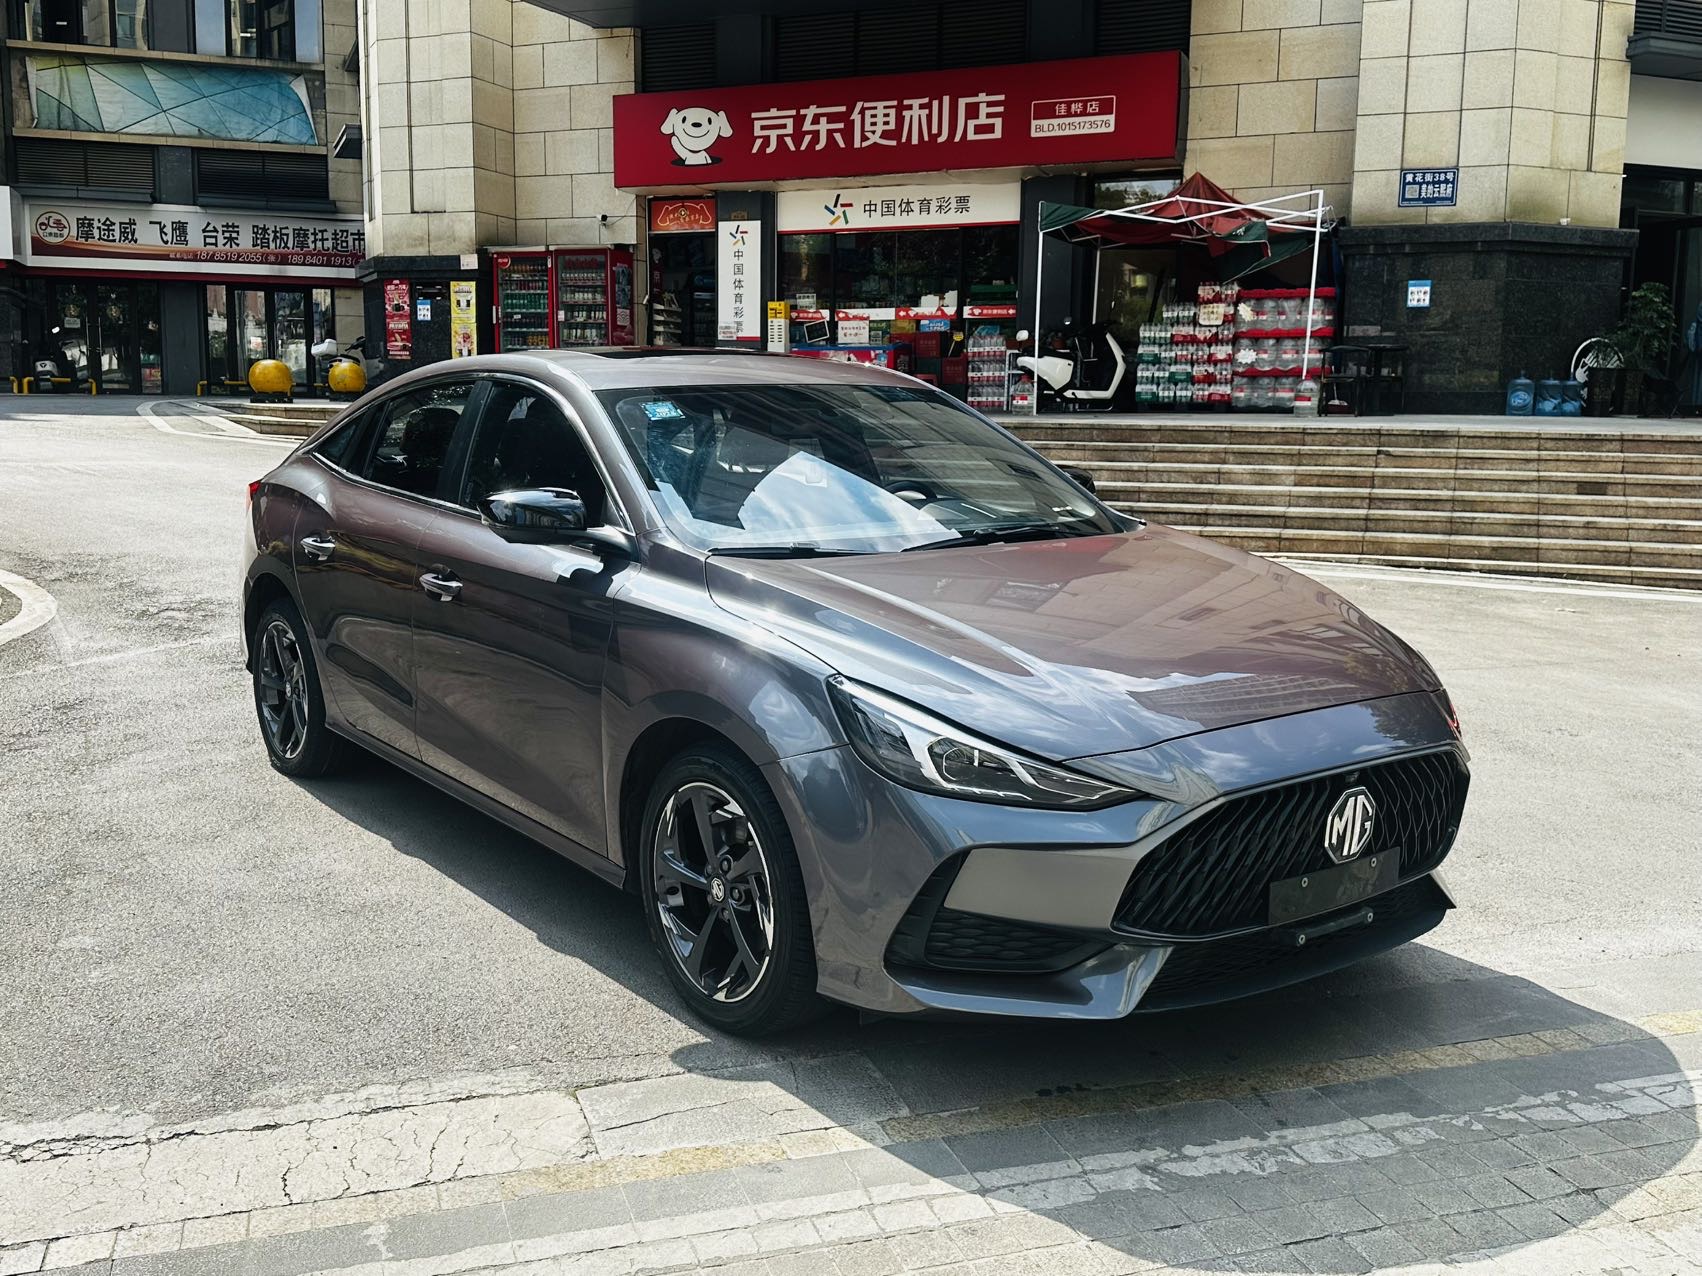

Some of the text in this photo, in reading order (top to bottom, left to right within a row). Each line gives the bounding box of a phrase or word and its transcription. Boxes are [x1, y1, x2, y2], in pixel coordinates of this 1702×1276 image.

[1055, 102, 1100, 116] 佳桦店
[751, 93, 1006, 154] 京东便利店
[1035, 119, 1111, 134] BLD.1015173576
[1405, 172, 1454, 183] 黄花街38号
[863, 195, 971, 218] 中国体育彩票
[75, 215, 365, 255] 摩途威 飞鹰 台荣 踏板摩托超市
[196, 250, 212, 260] 187
[214, 251, 237, 261] 8519
[287, 254, 303, 264] 189
[305, 255, 327, 265] 8401
[1331, 794, 1373, 856] MG
